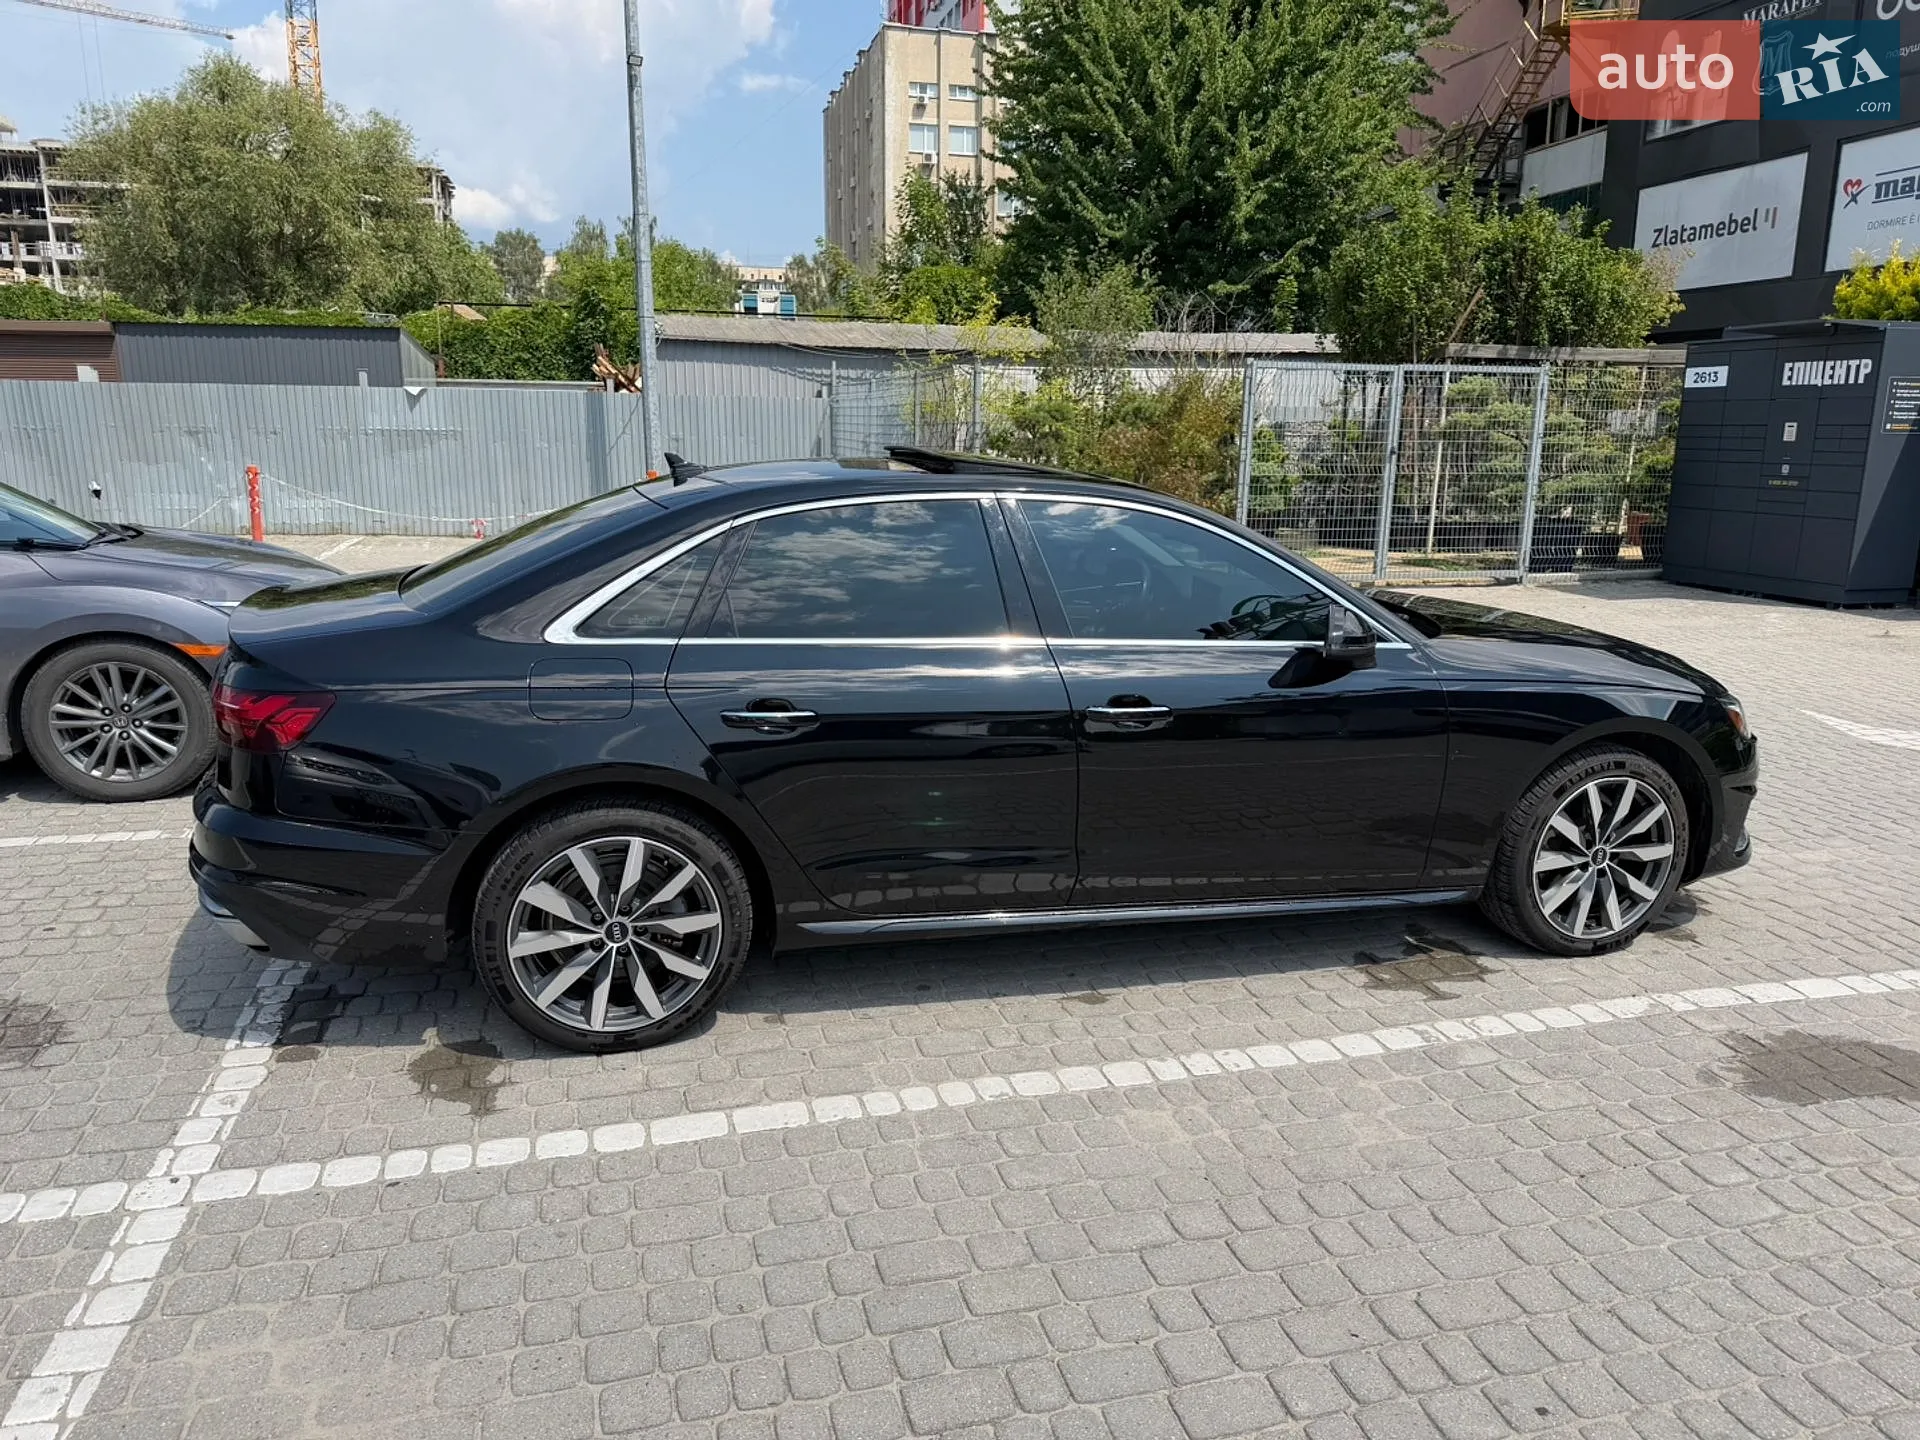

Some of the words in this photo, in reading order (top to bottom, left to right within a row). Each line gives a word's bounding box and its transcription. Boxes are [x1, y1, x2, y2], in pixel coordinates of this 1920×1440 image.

[1875, 175, 1920, 199] ma
[1651, 207, 1758, 248] Zlatamebel
[1693, 371, 1719, 384] 2613
[1782, 359, 1872, 386] ЕПІЦЕНТР
